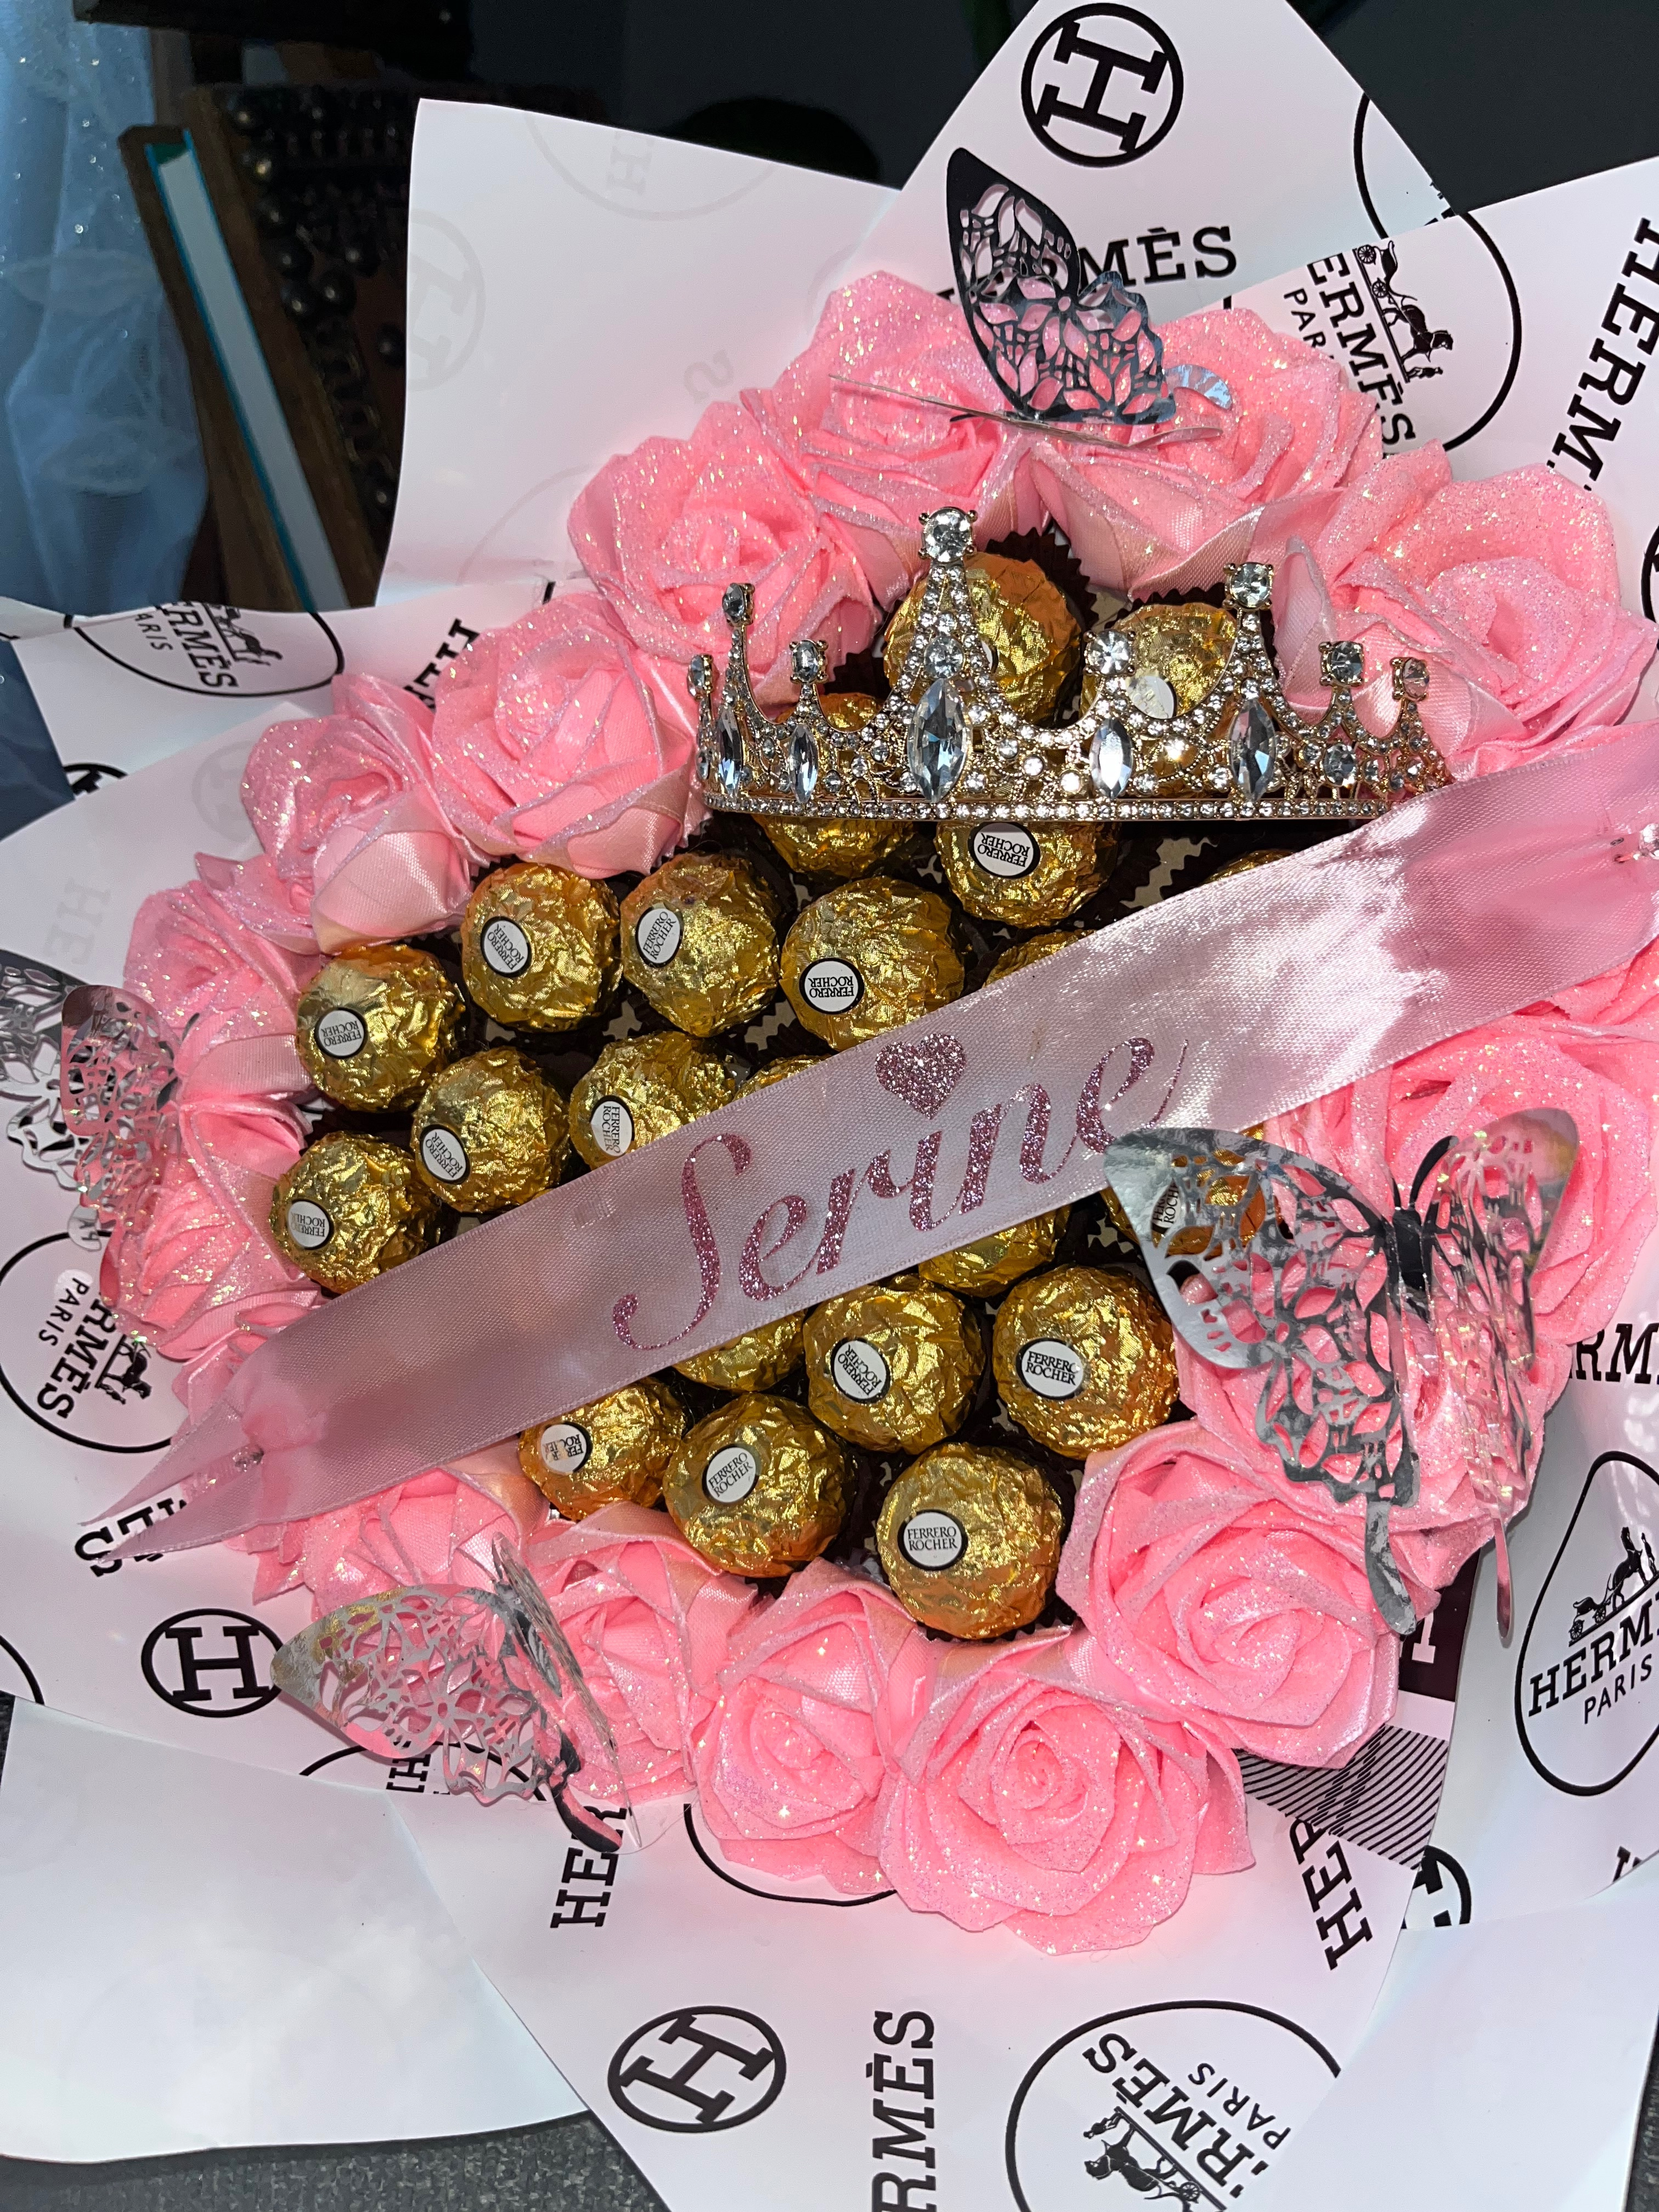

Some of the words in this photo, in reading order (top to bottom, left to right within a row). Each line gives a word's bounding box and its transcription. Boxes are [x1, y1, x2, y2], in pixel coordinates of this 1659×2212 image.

[1284, 288, 1334, 359] PAR
[1546, 217, 1659, 492] HERM
[977, 844, 1028, 867] FERRERO
[980, 833, 1030, 857] ROCHER
[487, 931, 517, 970] FERRERO
[494, 923, 525, 964] ROCHER
[642, 911, 669, 954] FERRERO
[649, 918, 676, 961] ROCHER
[808, 976, 854, 988] ROCHER
[809, 986, 855, 998] FERRERO
[320, 1020, 359, 1037] ROCHER
[324, 1030, 362, 1047] FERRERO
[602, 1105, 614, 1152] ROCHER
[611, 1106, 621, 1154] FERRERO
[425, 1138, 458, 1178] FERRERO
[431, 1132, 464, 1173] ROCHER
[613, 1034, 1189, 1350] Serine
[38, 1278, 89, 1346] PARIS
[837, 1353, 874, 1396] FERRERO
[844, 1344, 882, 1389] ROCHER
[1025, 1362, 1076, 1386] ROCHER
[708, 1452, 748, 1488] FERRERO
[713, 1461, 753, 1498] ROCHER
[907, 1526, 957, 1540] FERRERO
[909, 1537, 958, 1551] ROCHER
[164, 1625, 270, 1701] H
[1528, 1592, 1659, 1717] HERM
[1584, 1653, 1652, 1724] PARIS
[618, 2013, 776, 2124] H
[1082, 2033, 1268, 2198] RMÈS
[1188, 2062, 1291, 2150] PARIS
